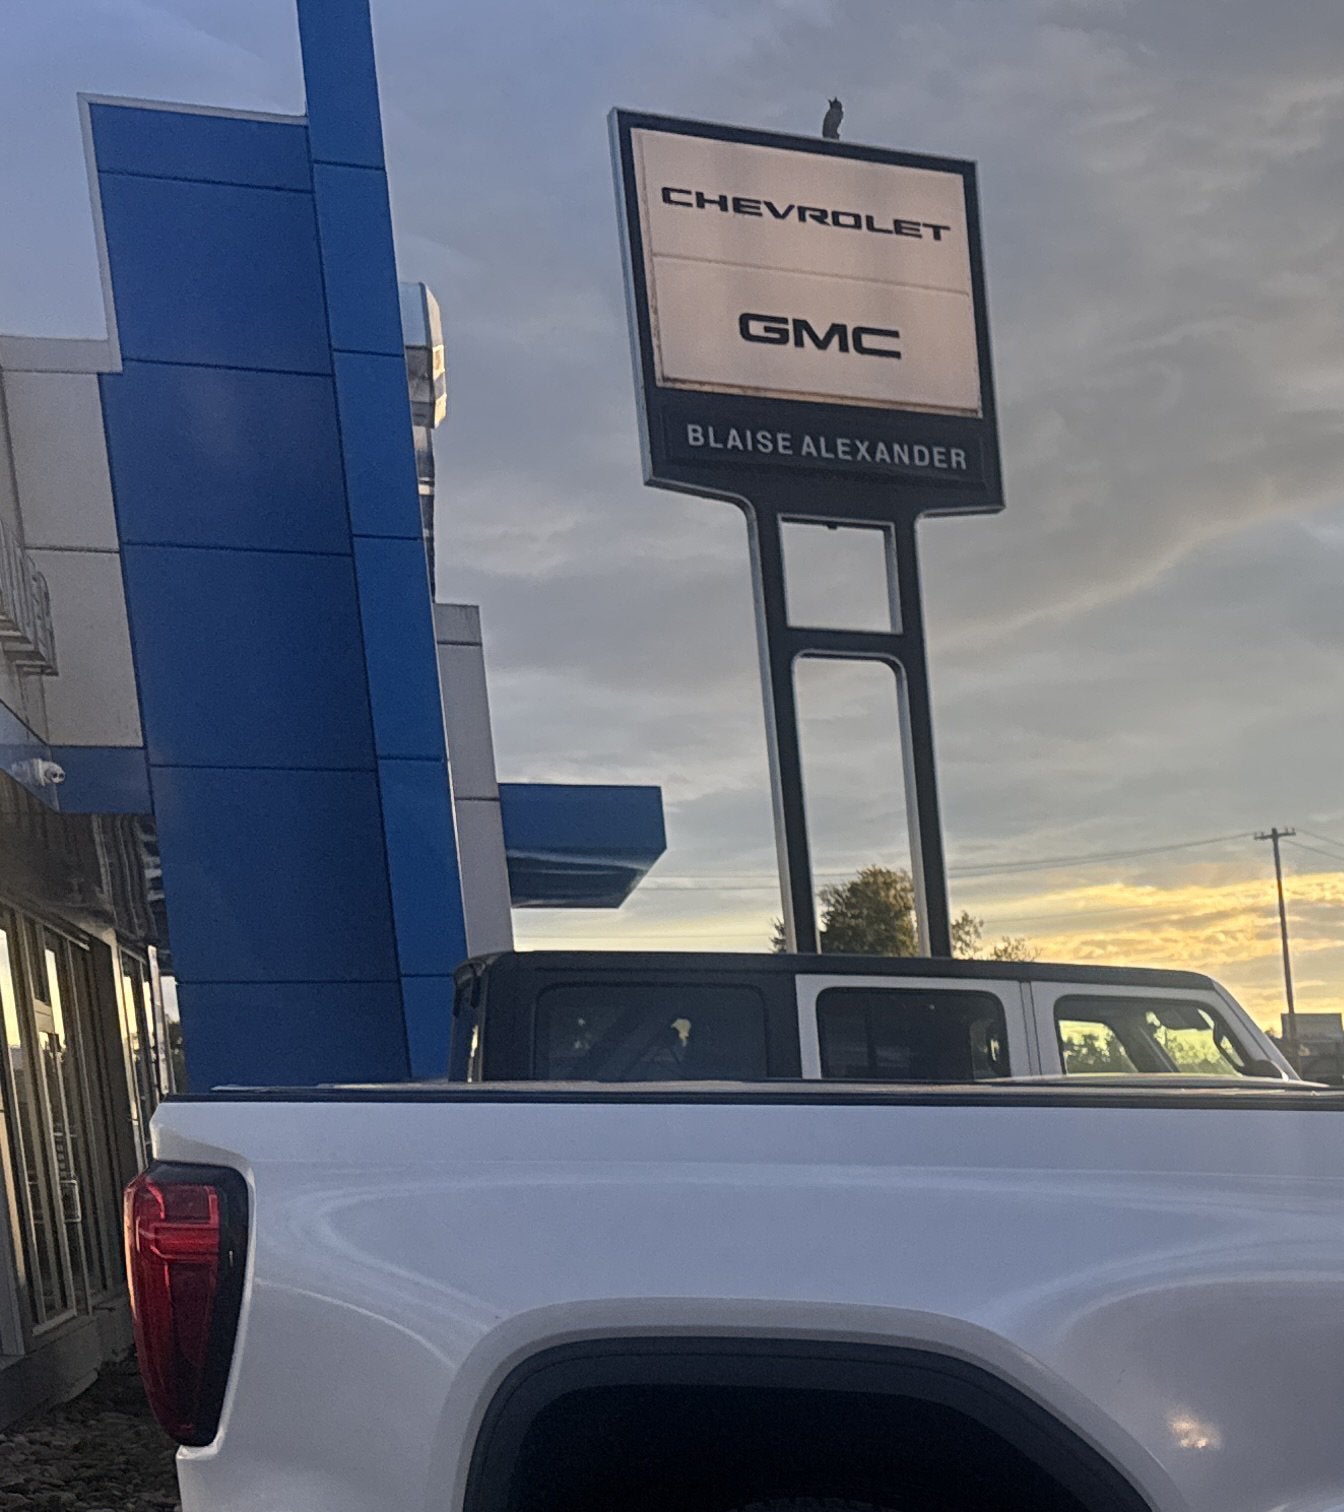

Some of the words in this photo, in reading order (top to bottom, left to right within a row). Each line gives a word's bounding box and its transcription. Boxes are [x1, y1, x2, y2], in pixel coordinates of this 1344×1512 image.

[661, 186, 950, 241] CHEVROLET
[738, 312, 902, 359] GMC
[687, 424, 793, 455] BLAISE
[800, 431, 967, 470] ALEXANDER
